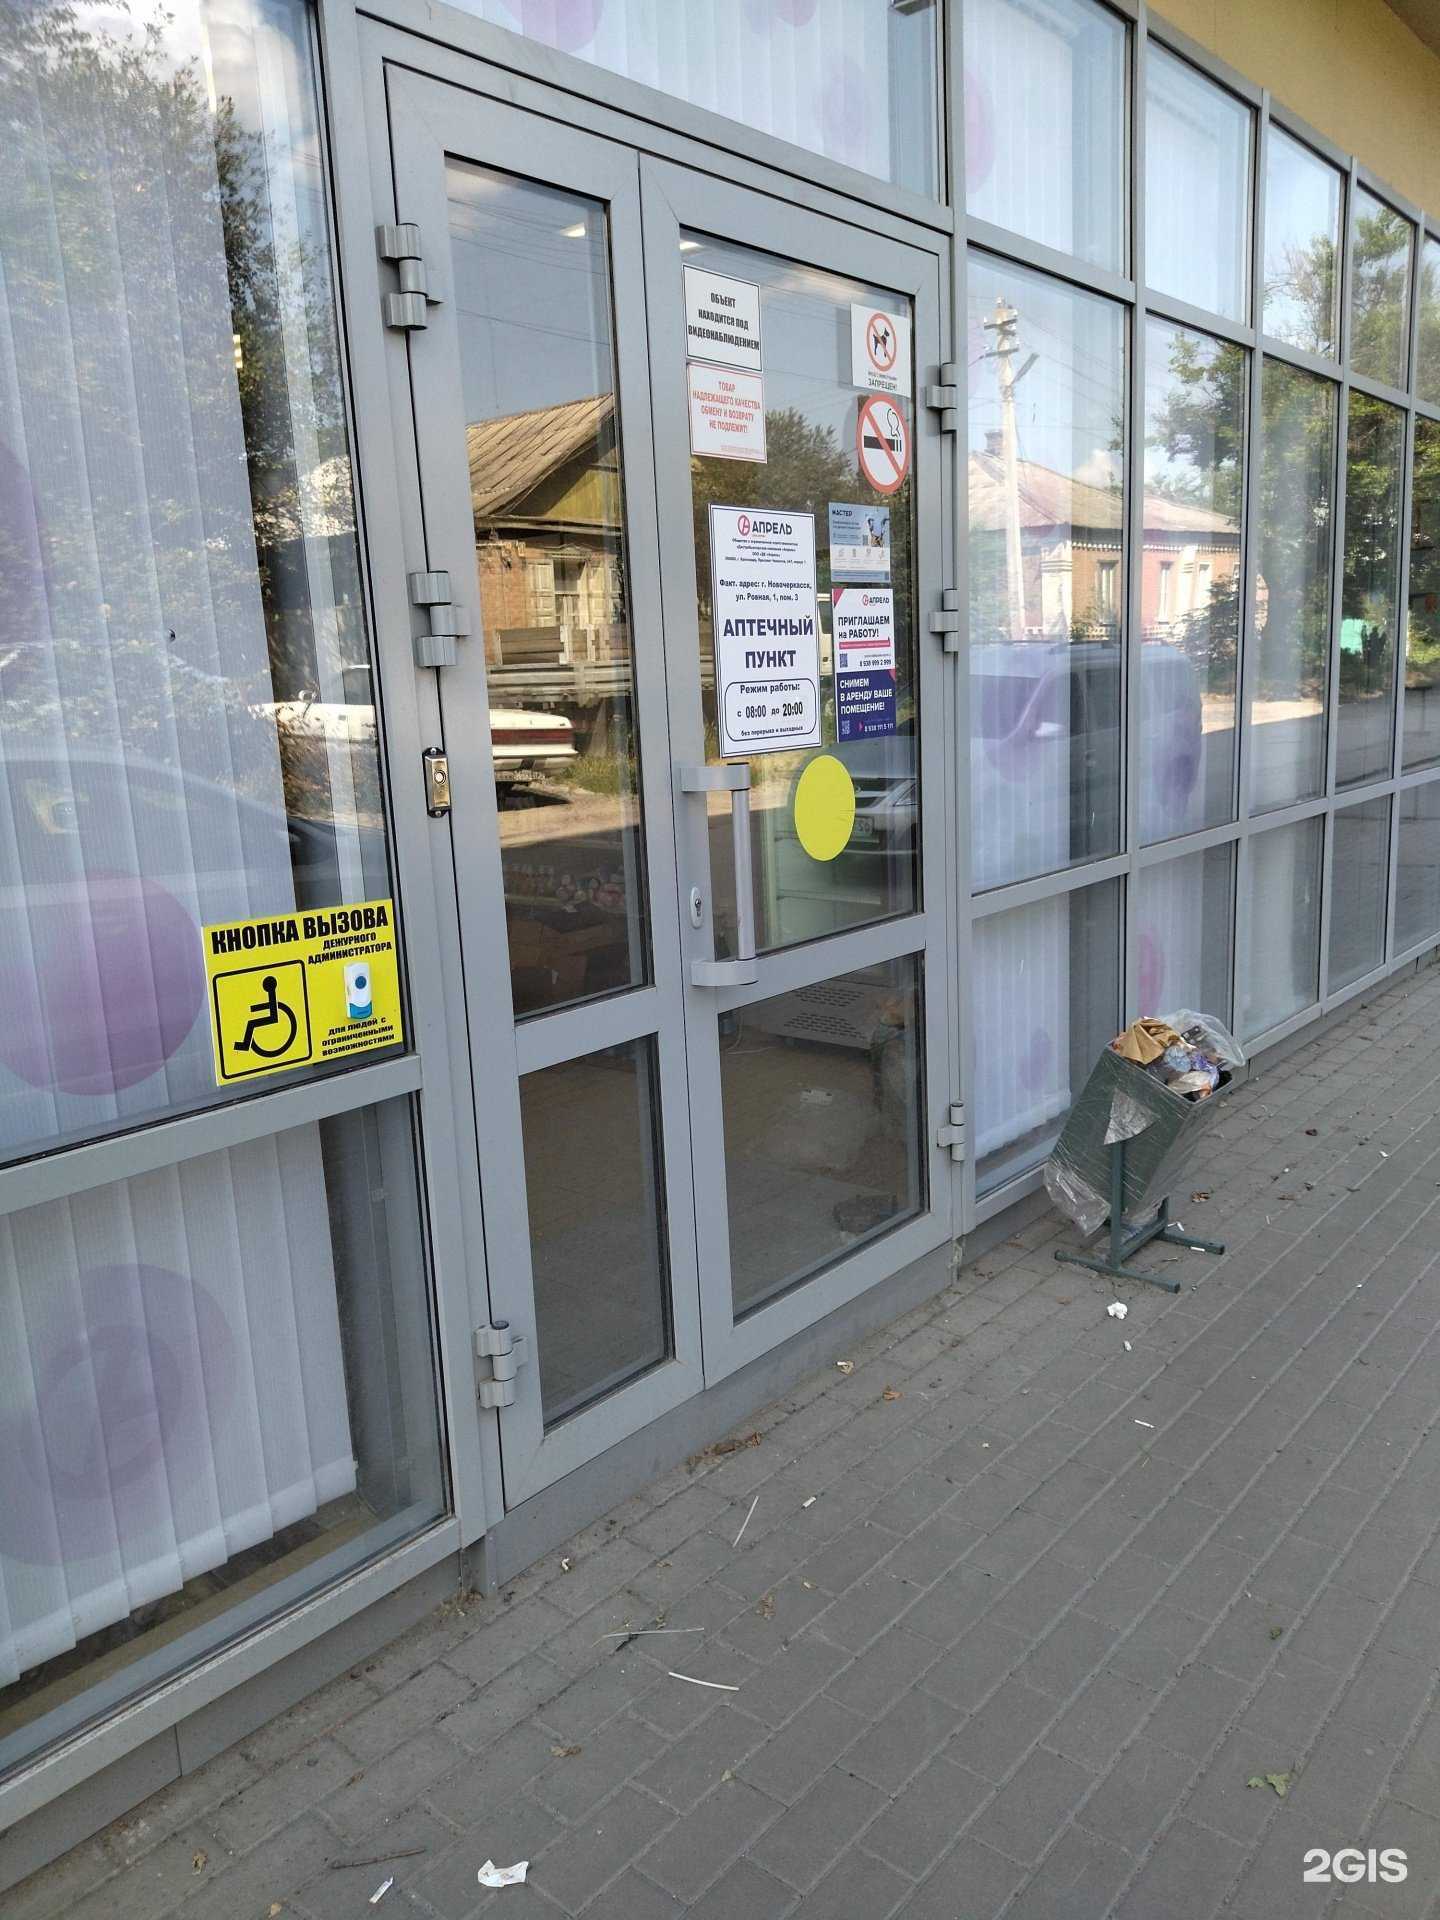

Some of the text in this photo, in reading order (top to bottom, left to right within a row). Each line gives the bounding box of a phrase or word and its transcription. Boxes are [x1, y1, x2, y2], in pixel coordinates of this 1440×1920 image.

[710, 292, 736, 308] ОБЪЕКТ
[698, 308, 749, 331] НАХОДИТСЯ ПОД
[687, 324, 760, 351] ВИДЕОНАБЛЮДЕНИЕМ
[718, 381, 736, 392] ТОВАР
[692, 389, 761, 410] НАДЛЕЖАЩЕГО КАЧЕСТВА
[701, 404, 754, 422] ОБМЕНУ И ВОЗВРАТУ
[709, 419, 716, 430] НЕ
[752, 520, 793, 535] АПРЕЛЬ
[720, 578, 738, 588] Факт.
[738, 581, 760, 589] адрес:
[736, 594, 746, 602] ул.
[869, 595, 890, 604] АПРЕЛЬ
[723, 615, 814, 637] АПТЕЧНЫЙ
[838, 615, 890, 627] ПРИГЛАШАЕМ
[848, 628, 879, 639] РАБОТУ!
[745, 650, 797, 669] ПУНКТ
[740, 682, 800, 695] Режим работы:
[840, 678, 870, 689] СНИМЕМ
[840, 688, 892, 702] В АРЕНДУ ВАШЕ
[745, 704, 767, 719] 08:00
[772, 708, 780, 716] до
[782, 701, 804, 717] 20:00
[840, 701, 885, 715] ПОМЕЩЕНИЕ!
[211, 905, 389, 955] КНОПКА ВЫЗОВА
[322, 931, 377, 951] ДЕЖУРНОГО
[307, 941, 393, 965] АДМИНИСТРАТОРА
[321, 1025, 394, 1047] ограниченными
[328, 1026, 346, 1036] для
[321, 1034, 395, 1057] возможностями
